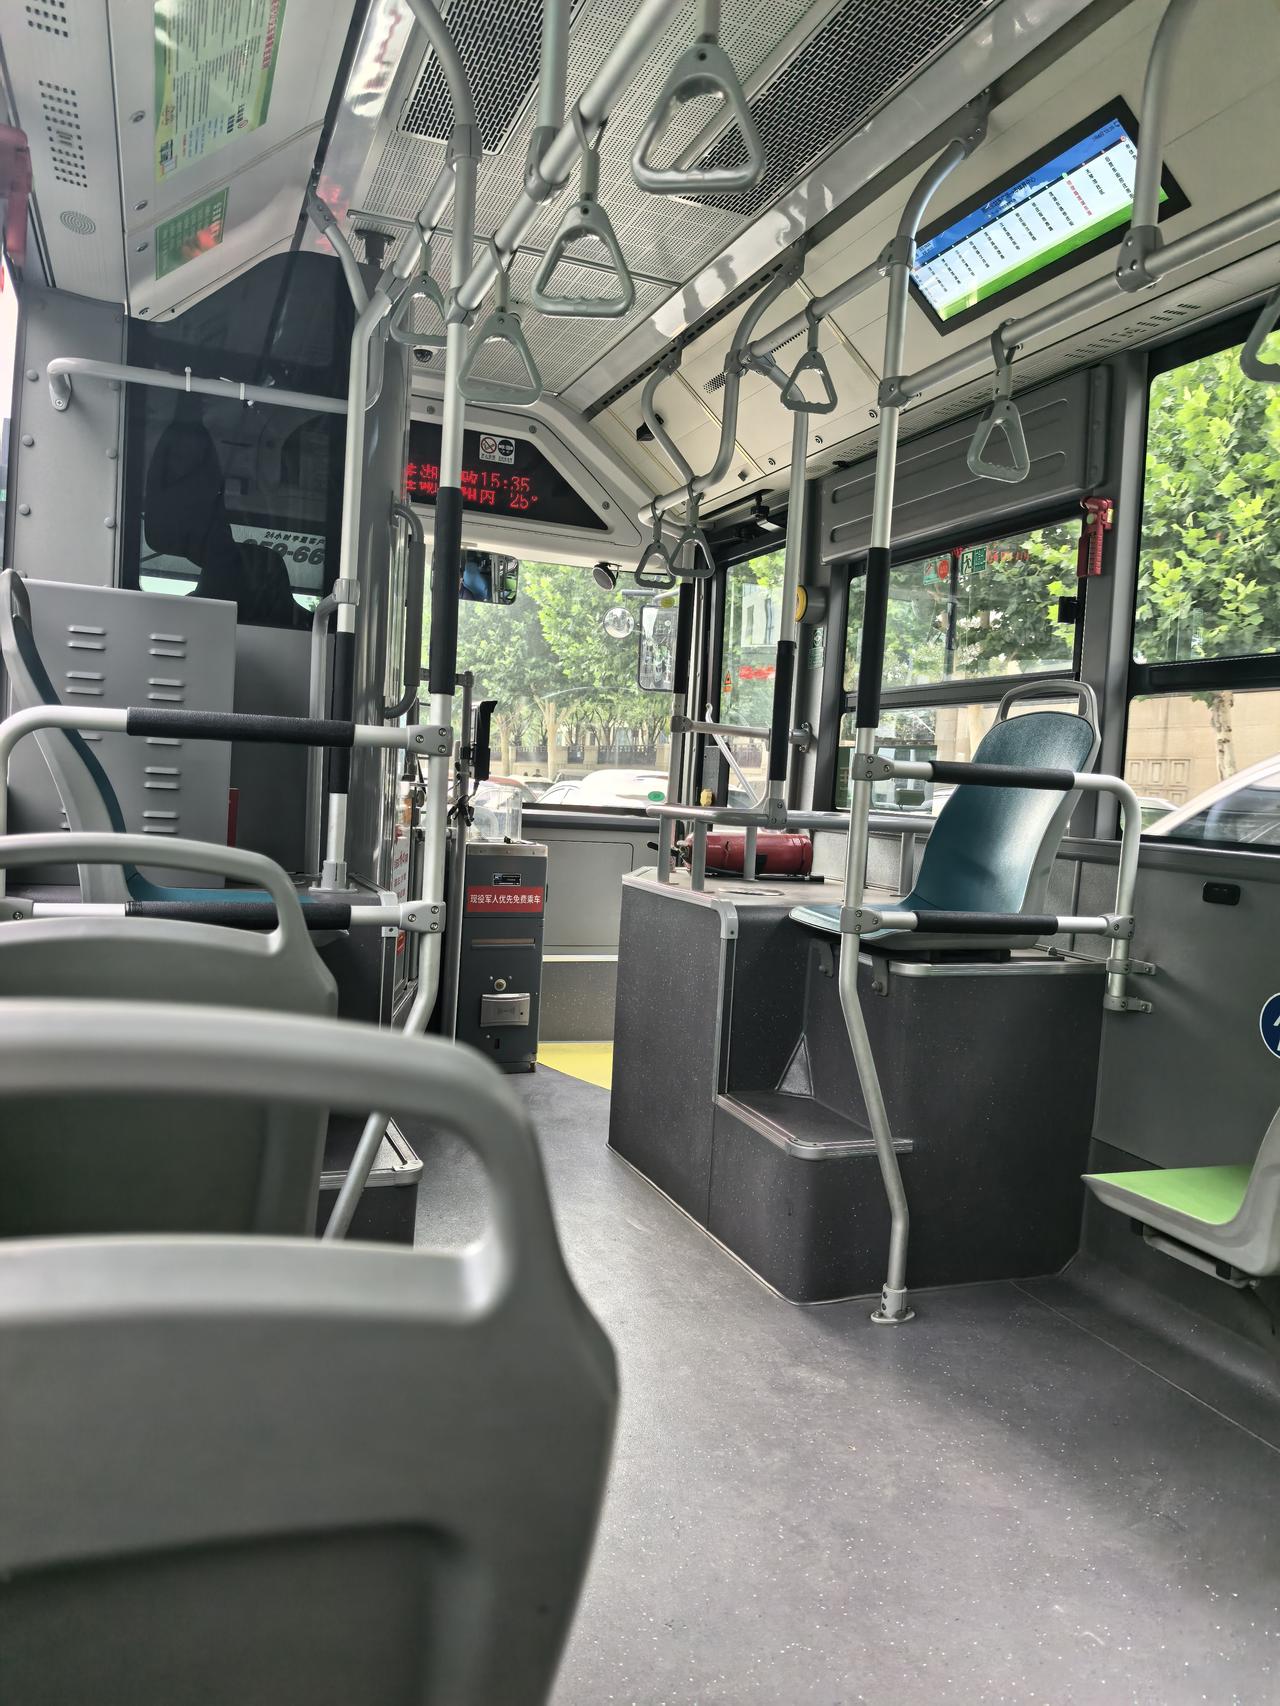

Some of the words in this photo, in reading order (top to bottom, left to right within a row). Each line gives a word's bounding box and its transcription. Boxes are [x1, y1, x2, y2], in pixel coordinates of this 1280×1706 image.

[470, 894, 542, 905] 现役军人优先免费乘车
